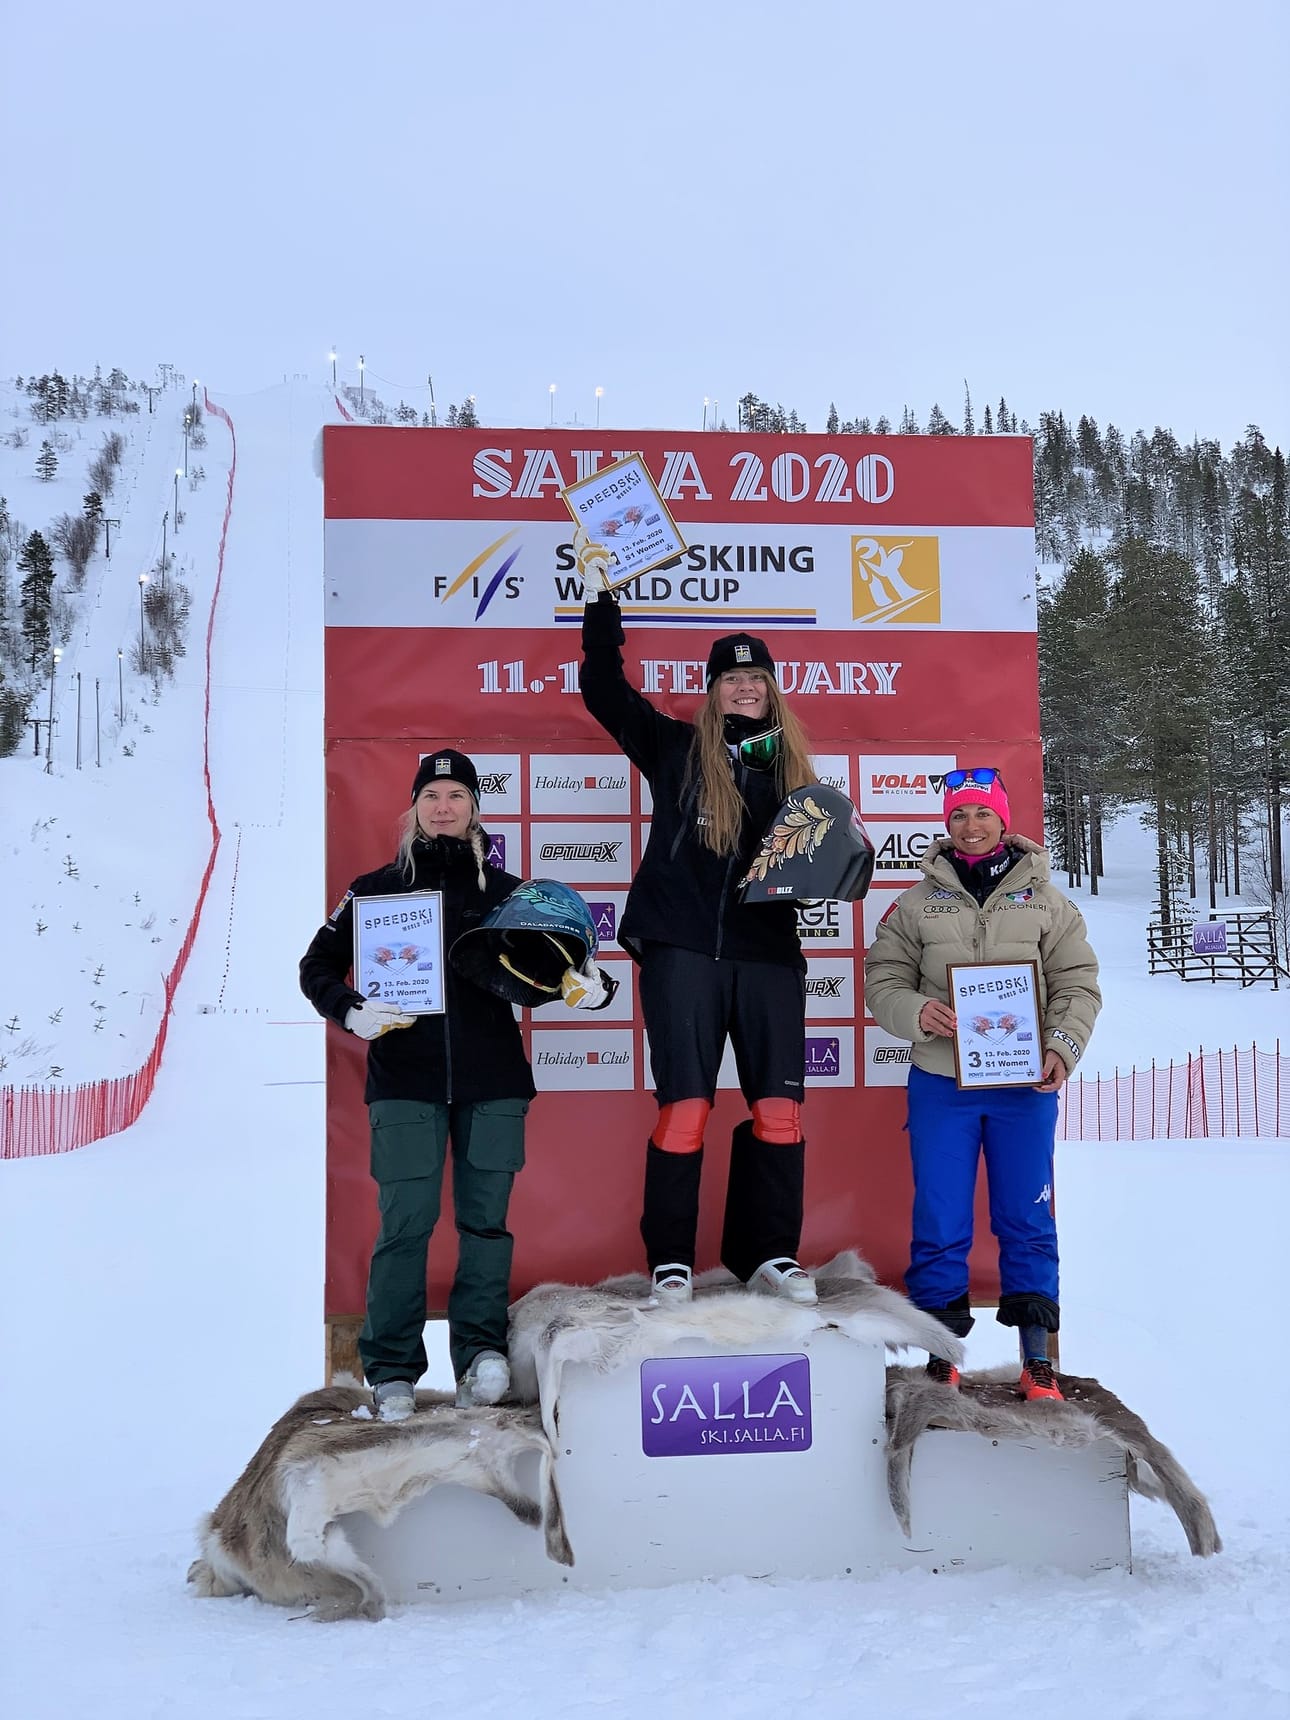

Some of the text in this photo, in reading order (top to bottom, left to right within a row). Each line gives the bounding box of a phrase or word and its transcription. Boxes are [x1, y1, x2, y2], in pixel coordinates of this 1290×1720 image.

[472, 448, 895, 504] SAA 2020
[579, 469, 641, 513] SPEEDSKI
[646, 528, 663, 540] 2020
[636, 538, 665, 556] Women
[687, 544, 815, 573] SKIING
[554, 576, 740, 602] WRLD CUP
[478, 659, 902, 695] 11.-1 FEUARY
[535, 776, 627, 793] Holiday Club
[819, 776, 846, 789] Club
[871, 774, 927, 788] VOLA
[540, 842, 622, 862] OPTIWAX
[797, 901, 839, 926] GE
[993, 903, 1048, 913] FALCONERI
[364, 908, 433, 930] SPEEDSKI
[1194, 930, 1225, 945] SALLA
[367, 981, 381, 998] 2
[412, 978, 430, 986] 2020
[397, 989, 427, 997] Women
[959, 976, 1028, 998] SPEEDSKI
[537, 1051, 630, 1068] Holiday Club
[873, 1047, 912, 1063] OPTI
[968, 1051, 982, 1069] 3
[998, 1060, 1029, 1068] Women
[650, 1380, 804, 1424] SALLA
[701, 1427, 805, 1444] SKI.SALLA.FI
